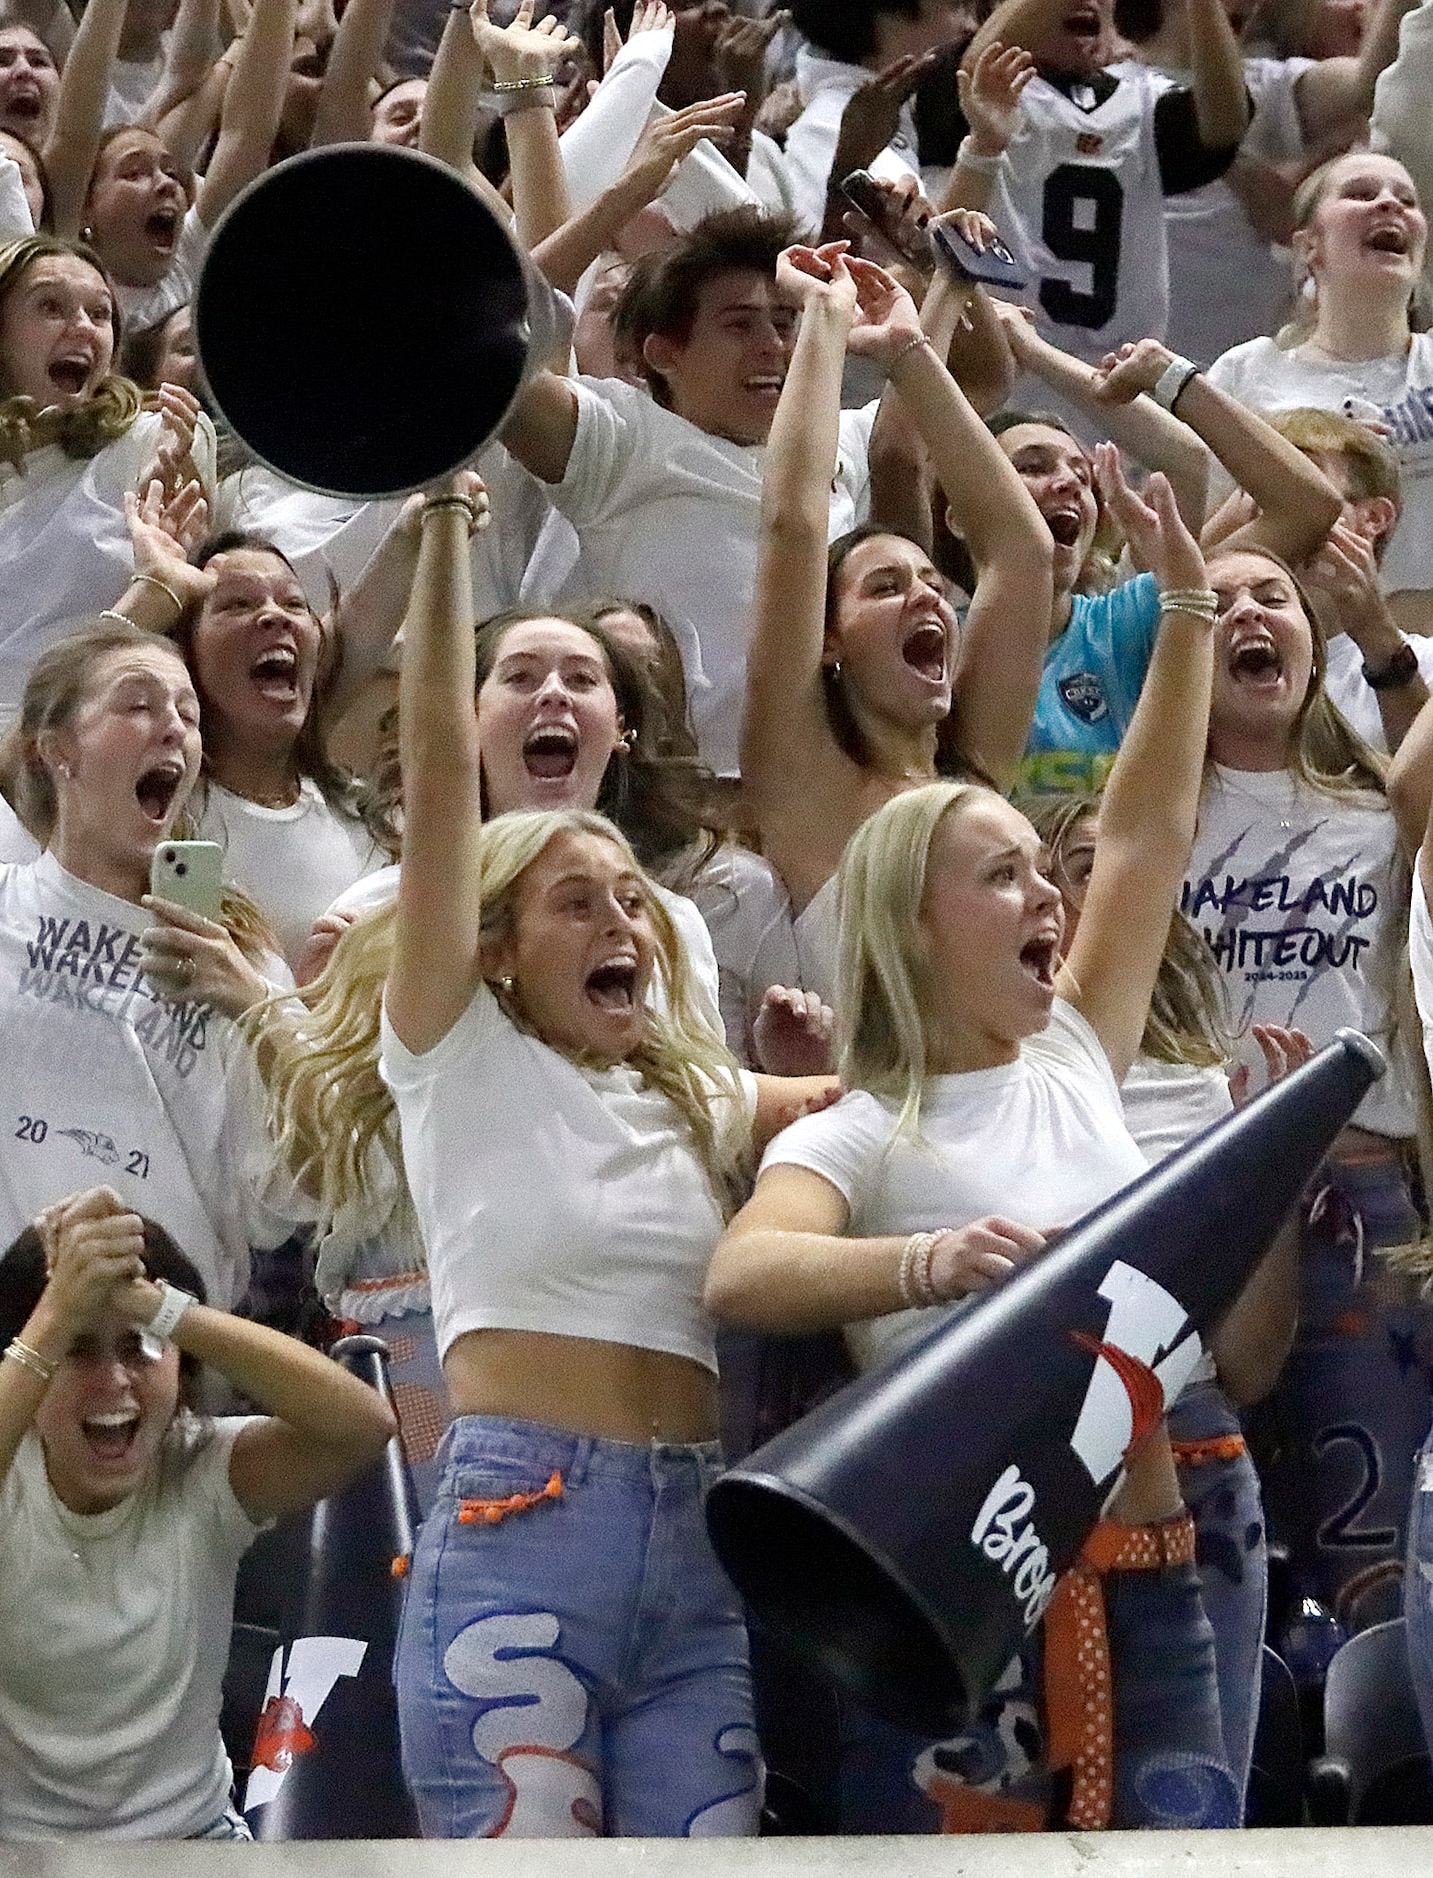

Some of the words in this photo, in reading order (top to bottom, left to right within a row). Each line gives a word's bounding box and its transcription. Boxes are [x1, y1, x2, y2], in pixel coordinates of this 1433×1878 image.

[1038, 163, 1123, 330] 9
[15, 1115, 48, 1144] 20
[125, 1150, 150, 1179] 21
[1315, 1422, 1397, 1549] 2
